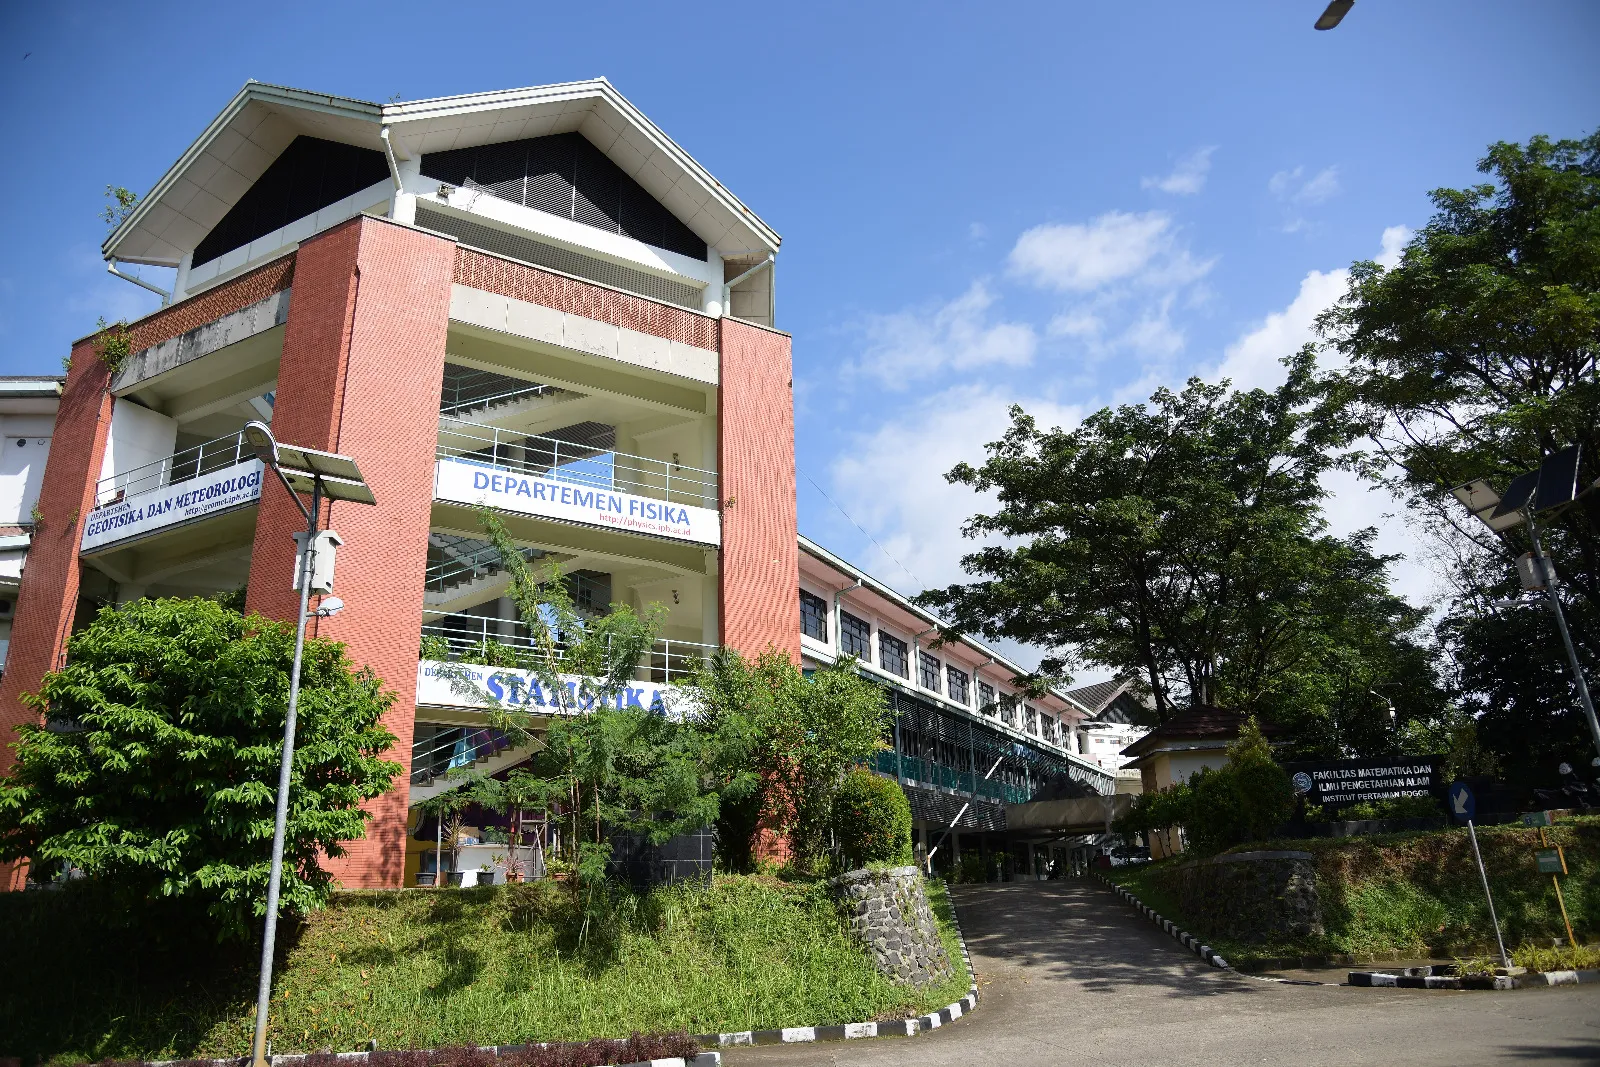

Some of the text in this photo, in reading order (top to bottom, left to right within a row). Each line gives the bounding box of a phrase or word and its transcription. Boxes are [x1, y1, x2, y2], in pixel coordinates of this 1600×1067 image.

[88, 471, 261, 536] GEOFISIKA DAN METEOROLOGI
[474, 471, 691, 525] DEPARTEMEN FISIKA
[91, 502, 131, 521] DEPARTEMEN
[600, 513, 691, 536] http://physics.ipb.ac.id
[425, 667, 483, 681] DEMEN
[487, 672, 667, 716] STAISIKA
[1313, 765, 1432, 780] FAKULTAS MATEMATIKA DAN
[1318, 776, 1430, 792] ILMU PENGETAHUAN ALAM
[1322, 789, 1430, 803] INSTITUT PERTANIAN BOGOR
